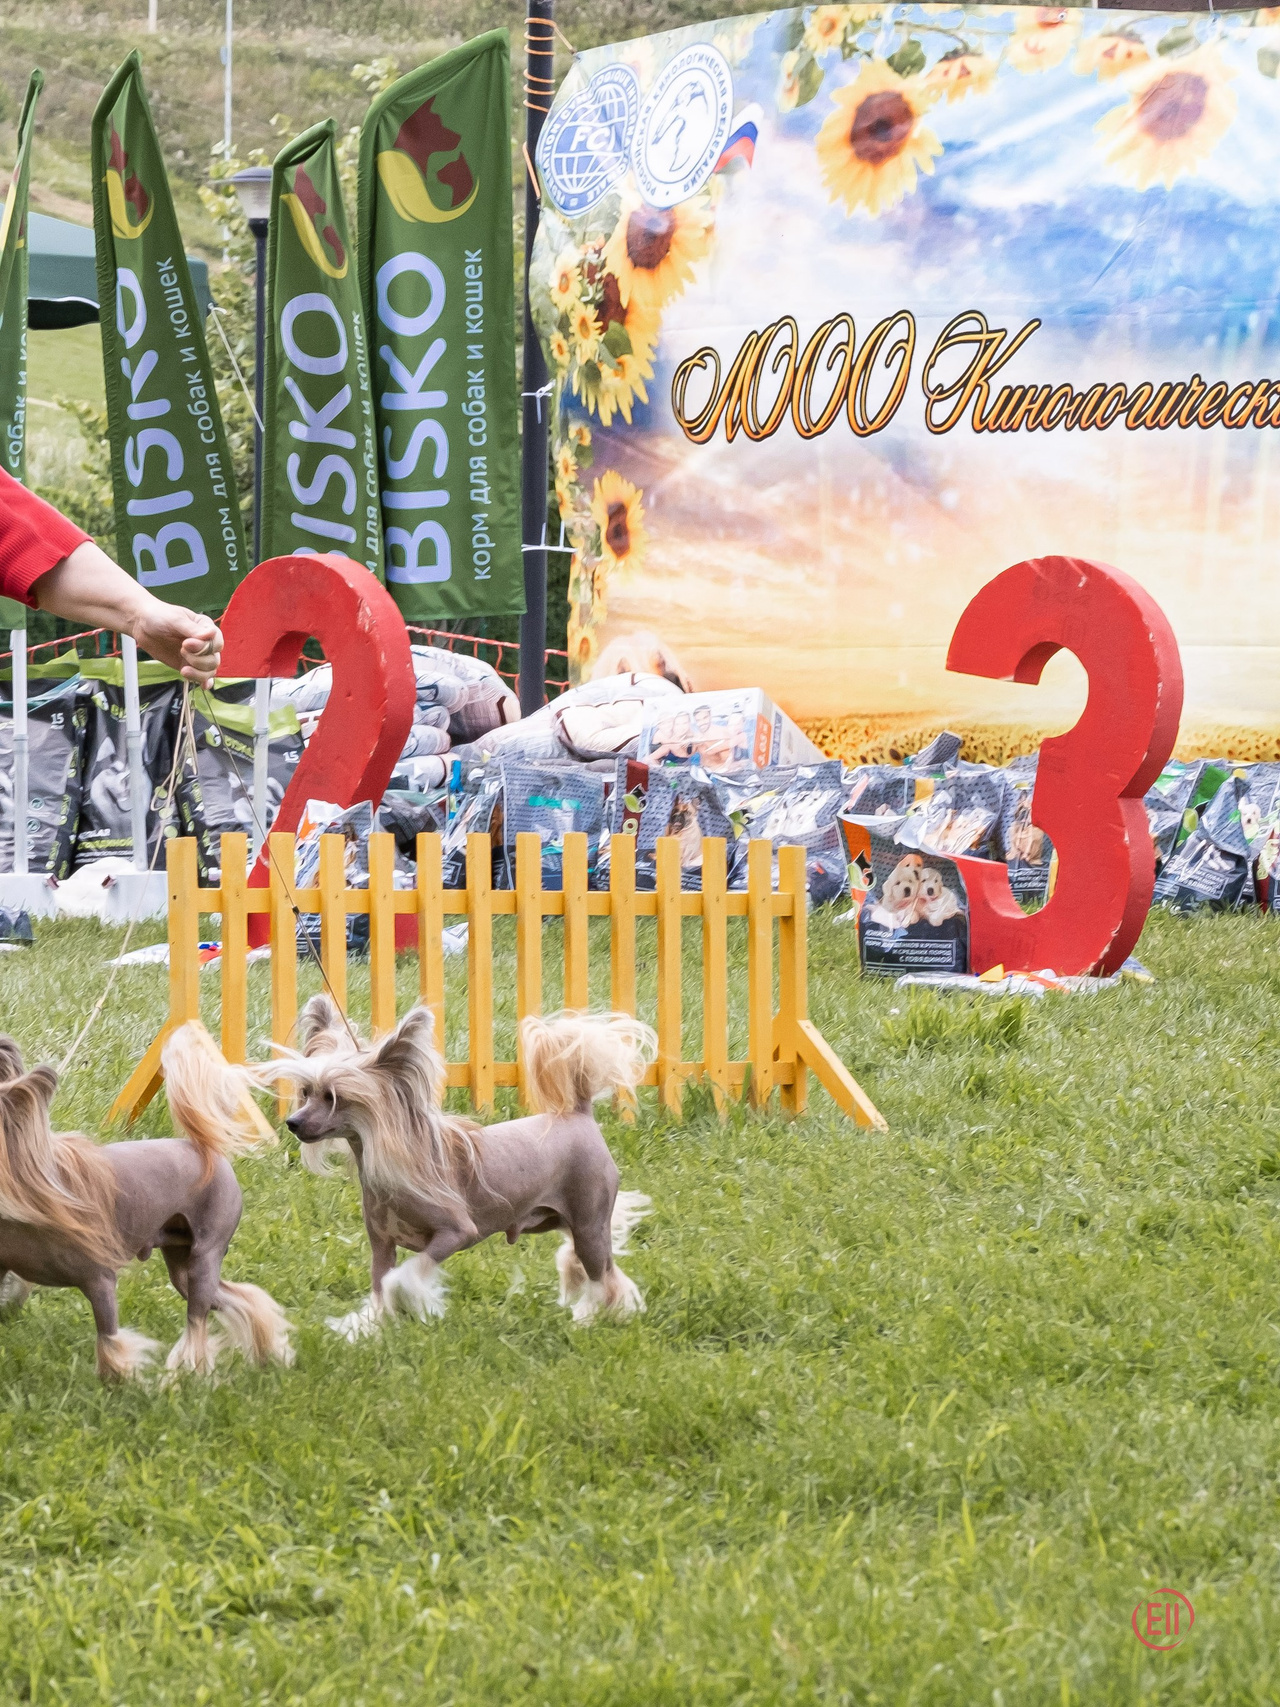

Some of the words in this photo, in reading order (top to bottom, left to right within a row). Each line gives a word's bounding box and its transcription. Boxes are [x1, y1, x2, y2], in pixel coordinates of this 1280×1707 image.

[683, 102, 728, 192] ФЕДЕРАЦИЯ
[157, 257, 192, 338] кошек
[464, 248, 484, 334] кошек
[180, 347, 196, 362] и
[467, 344, 483, 359] и
[921, 309, 1280, 435] Кинологическ
[116, 267, 210, 587] BISKO
[185, 369, 216, 444] собак
[280, 292, 357, 557] ISKO
[375, 251, 452, 584] BISKO
[462, 368, 488, 447] собак
[205, 453, 228, 499] для
[469, 456, 491, 505] для
[218, 507, 239, 571] корм
[366, 505, 379, 555] для
[471, 512, 495, 580] корм
[51, 713, 64, 725] 15
[283, 751, 299, 761] 15
[946, 555, 1184, 978] 3
